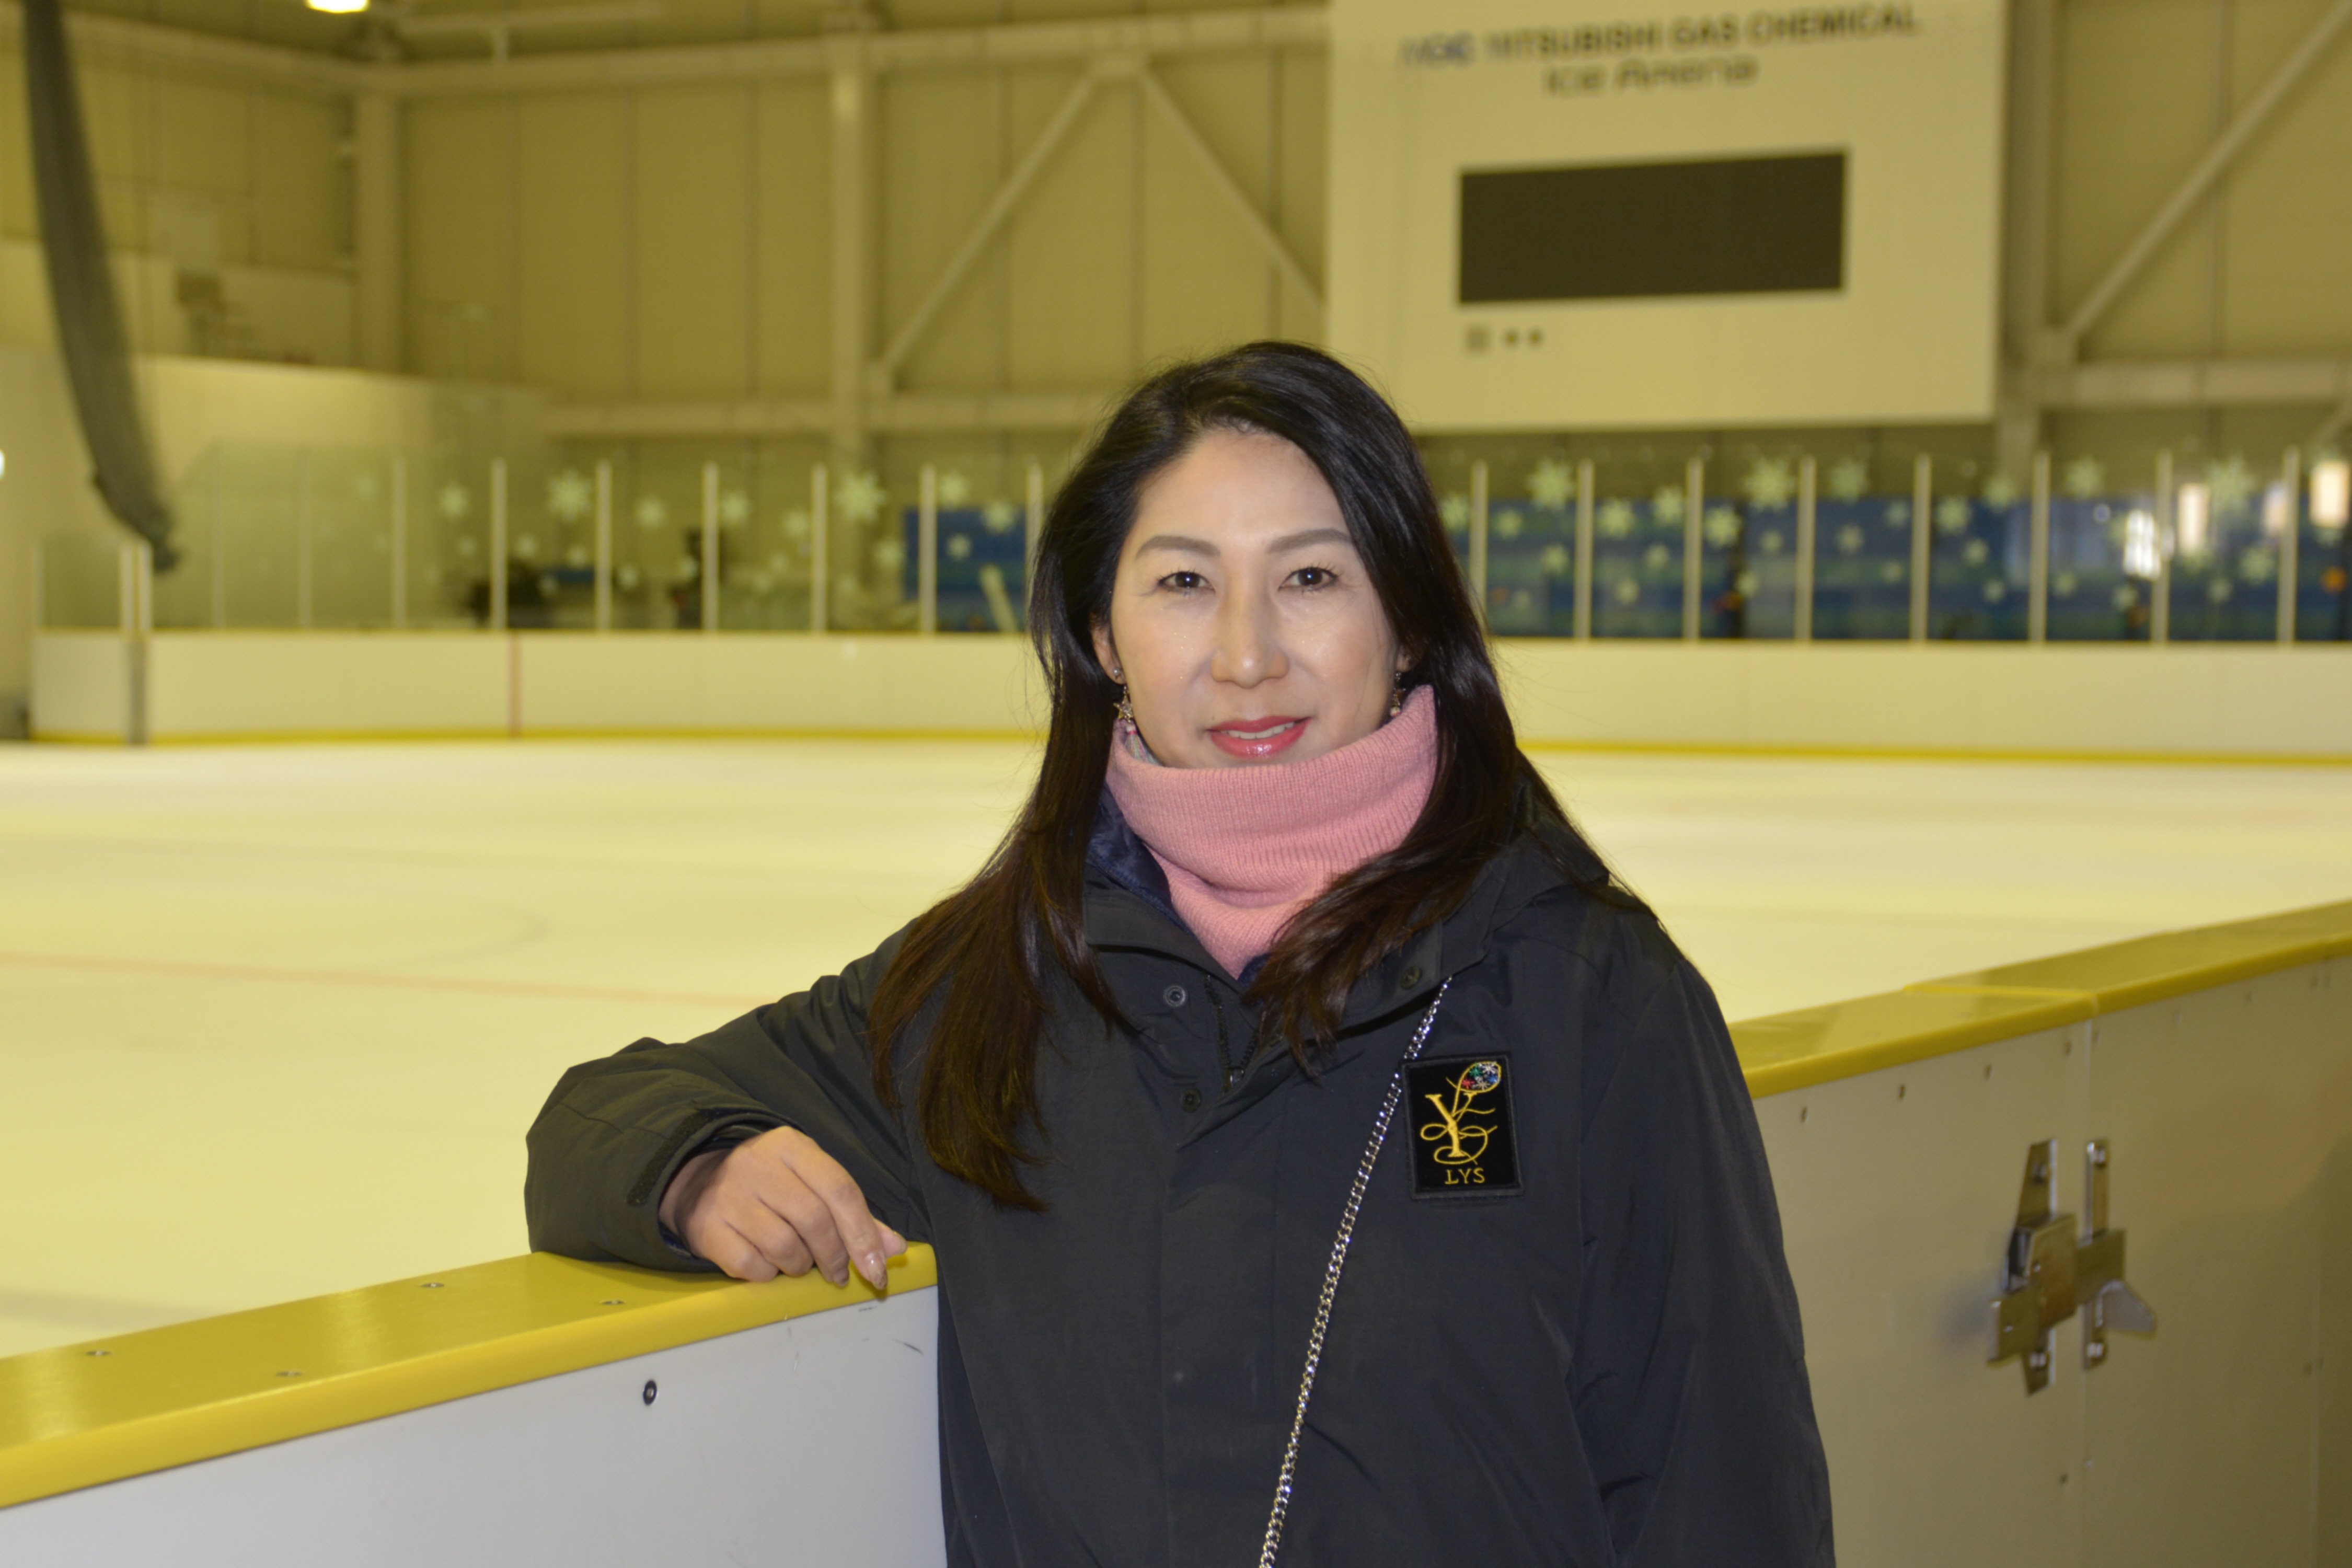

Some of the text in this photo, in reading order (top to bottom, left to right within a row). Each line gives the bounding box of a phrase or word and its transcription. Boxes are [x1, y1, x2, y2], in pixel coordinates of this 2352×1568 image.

[1484, 22, 1662, 61] MITSUBISHI
[1668, 15, 1739, 49] GAS
[1746, 4, 1920, 45] CHEMICAL
[1543, 57, 1759, 96] Ice Arena
[1445, 1167, 1485, 1184] LYS
